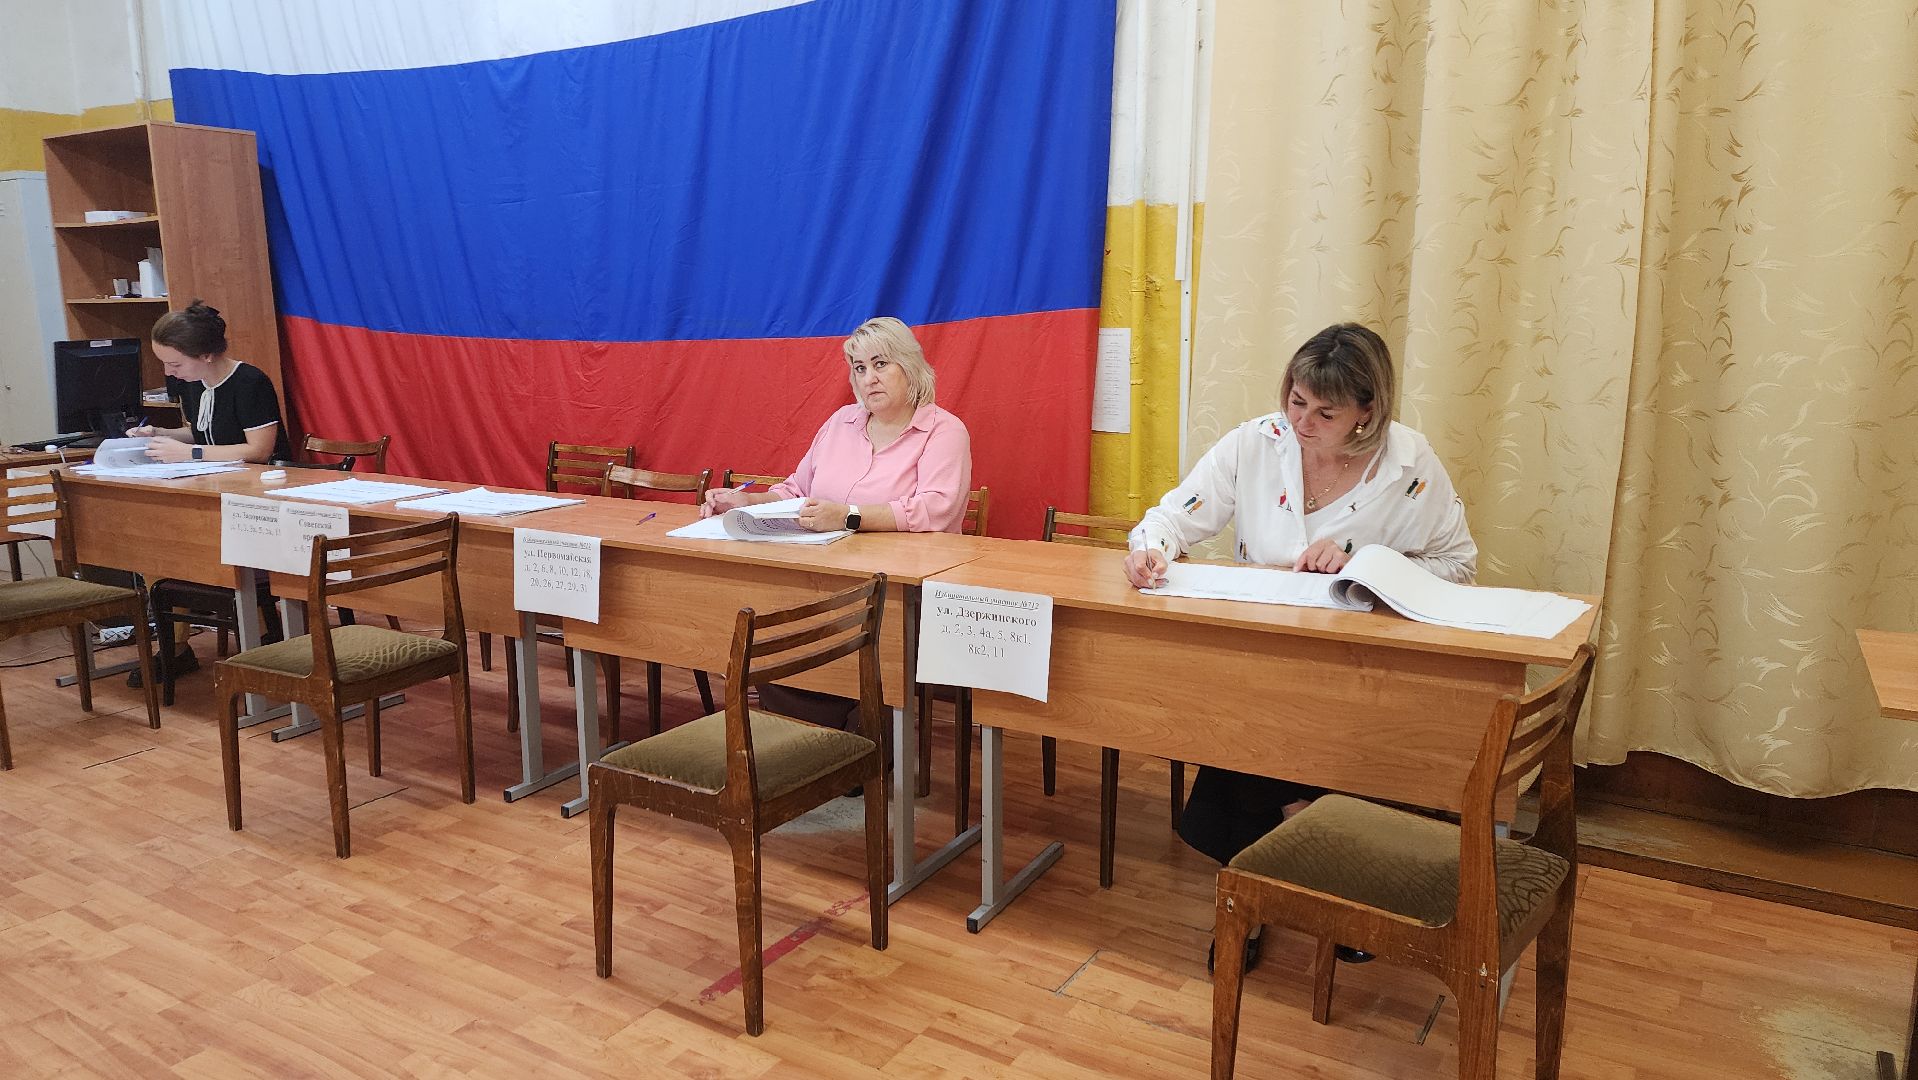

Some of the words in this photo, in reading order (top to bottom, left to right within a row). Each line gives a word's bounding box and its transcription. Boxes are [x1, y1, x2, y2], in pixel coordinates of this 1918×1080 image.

[537, 549, 592, 564] Первомайская
[936, 606, 953, 617] ул.
[955, 606, 1037, 627] Дзержинского
[954, 623, 964, 636] 2,
[979, 627, 995, 640] 4а,
[997, 629, 1007, 642] 5,
[968, 643, 990, 658] 8к2,
[993, 646, 1005, 658] 11
